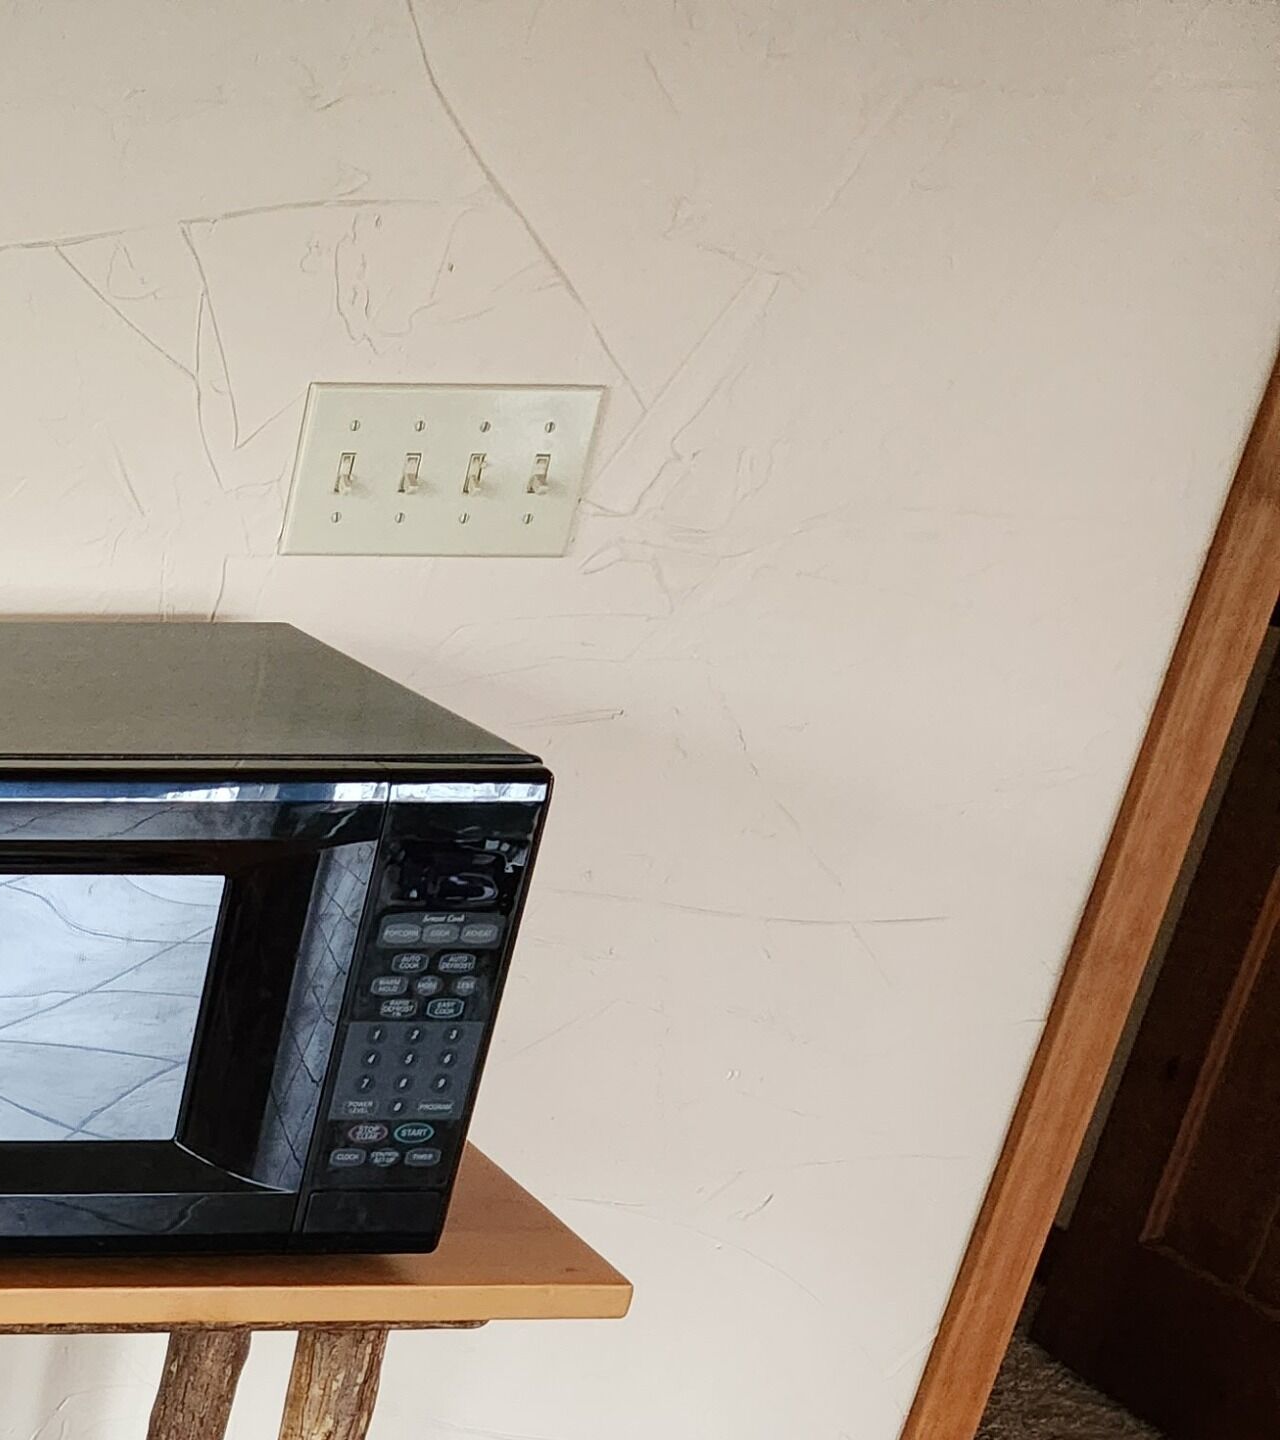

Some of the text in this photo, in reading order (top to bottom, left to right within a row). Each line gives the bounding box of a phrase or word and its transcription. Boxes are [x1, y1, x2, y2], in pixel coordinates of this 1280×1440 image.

[383, 929, 419, 937] POPCORN
[418, 1103, 453, 1111] PROGRAM
[358, 1125, 381, 1133] STOP
[401, 1128, 428, 1137] START
